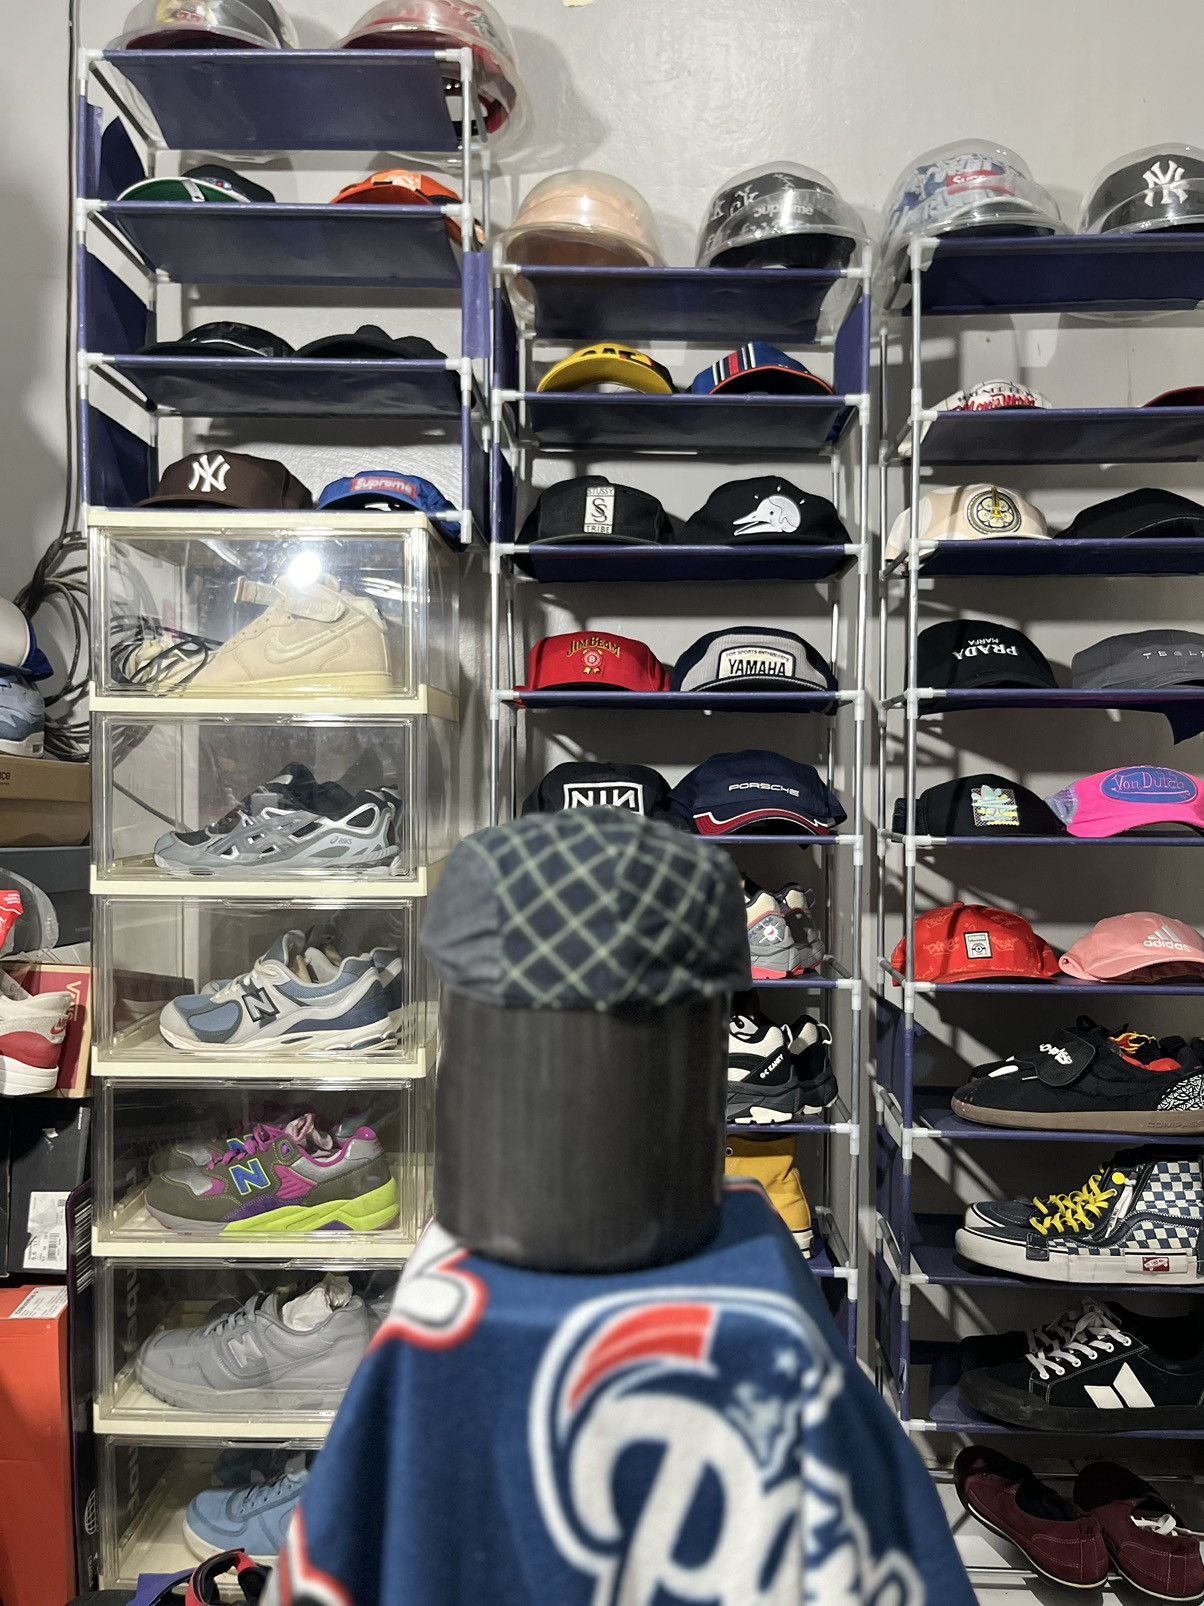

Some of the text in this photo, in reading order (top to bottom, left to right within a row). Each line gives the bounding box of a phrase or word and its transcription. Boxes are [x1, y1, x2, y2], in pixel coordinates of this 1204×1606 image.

[188, 454, 230, 492] NY
[353, 478, 413, 495] Supreme
[585, 525, 611, 534] TRIBE
[566, 636, 621, 659] JIM BEAM
[968, 637, 999, 646] MARFA
[952, 644, 1019, 660] PRADA
[728, 658, 786, 677] YAMAHA
[1111, 771, 1185, 791] Von Dutch
[728, 782, 800, 798] PORSCHE
[1143, 938, 1191, 953] adidas
[228, 1157, 271, 1196] N
